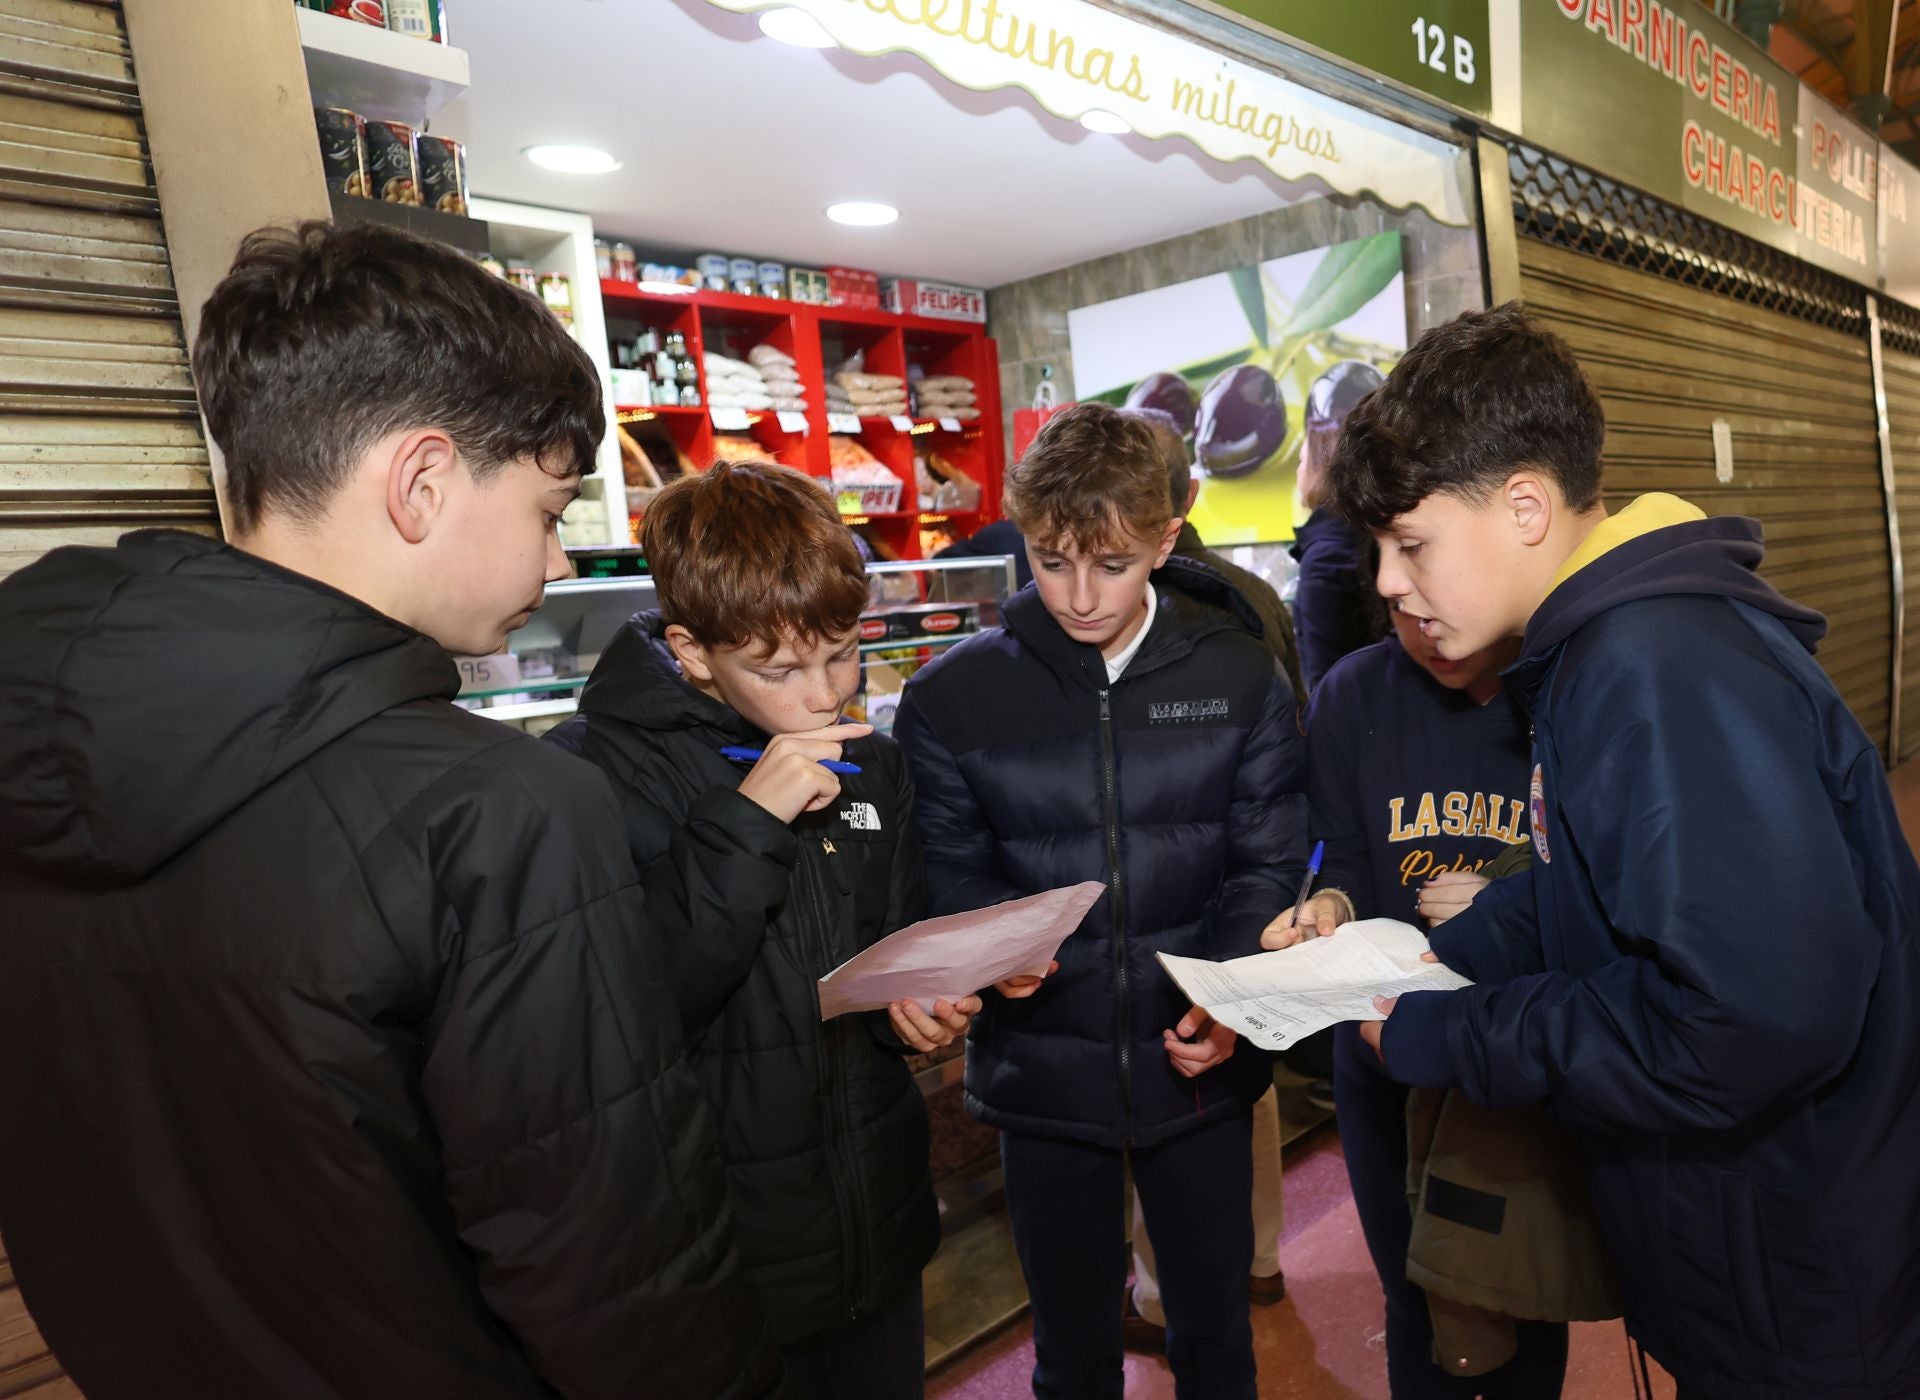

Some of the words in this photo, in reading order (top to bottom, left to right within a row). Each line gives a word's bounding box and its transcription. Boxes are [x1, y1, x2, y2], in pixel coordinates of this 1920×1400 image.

[1411, 16, 1447, 73] 12
[1453, 34, 1476, 84] B
[1172, 73, 1341, 163] milagros
[1681, 119, 1867, 266] CHARCUTERIA
[1388, 792, 1530, 845] LASALL
